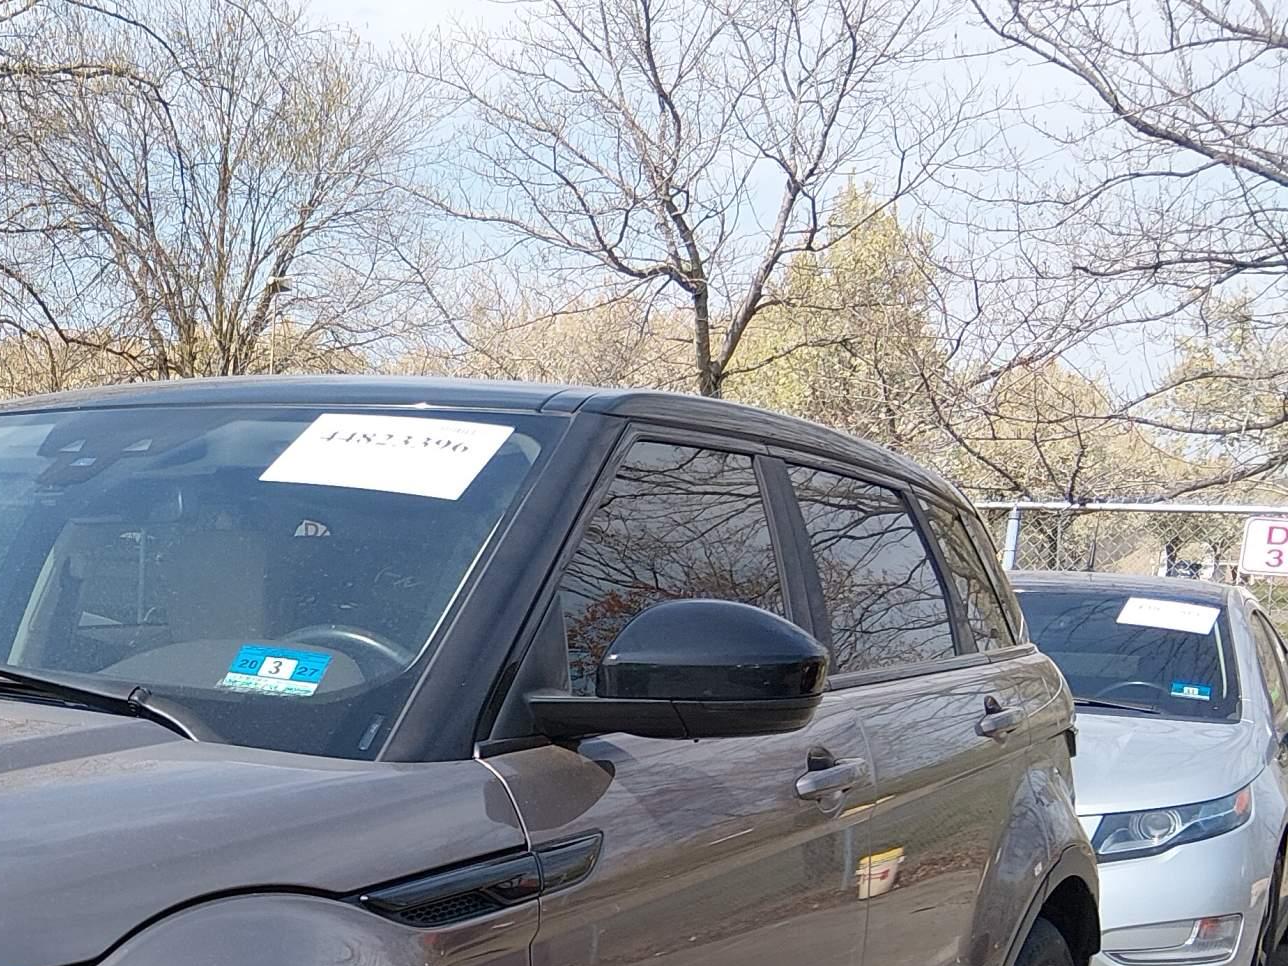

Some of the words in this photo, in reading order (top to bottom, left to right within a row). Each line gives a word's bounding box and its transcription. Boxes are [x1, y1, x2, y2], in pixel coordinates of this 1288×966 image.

[320, 431, 469, 453] 44823396
[238, 658, 258, 669] 20
[268, 660, 283, 675] 3
[296, 666, 320, 677] 27
